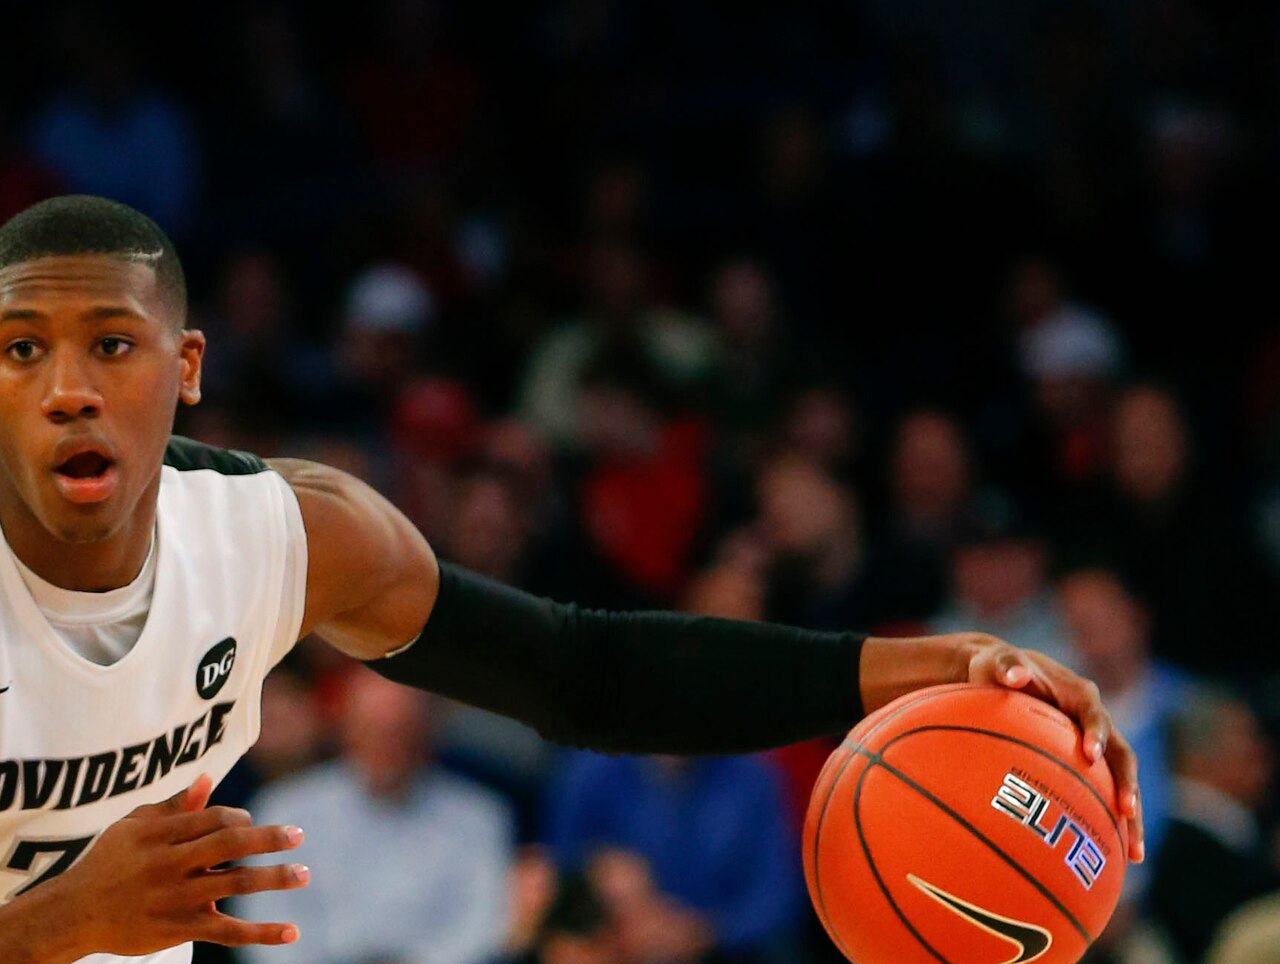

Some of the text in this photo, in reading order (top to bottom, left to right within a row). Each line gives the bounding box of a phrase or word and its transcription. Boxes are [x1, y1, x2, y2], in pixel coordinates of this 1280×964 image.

[201, 647, 235, 690] DG
[991, 772, 1107, 891] ELITE
[1009, 766, 1111, 857] CHAMPIONSHIP
